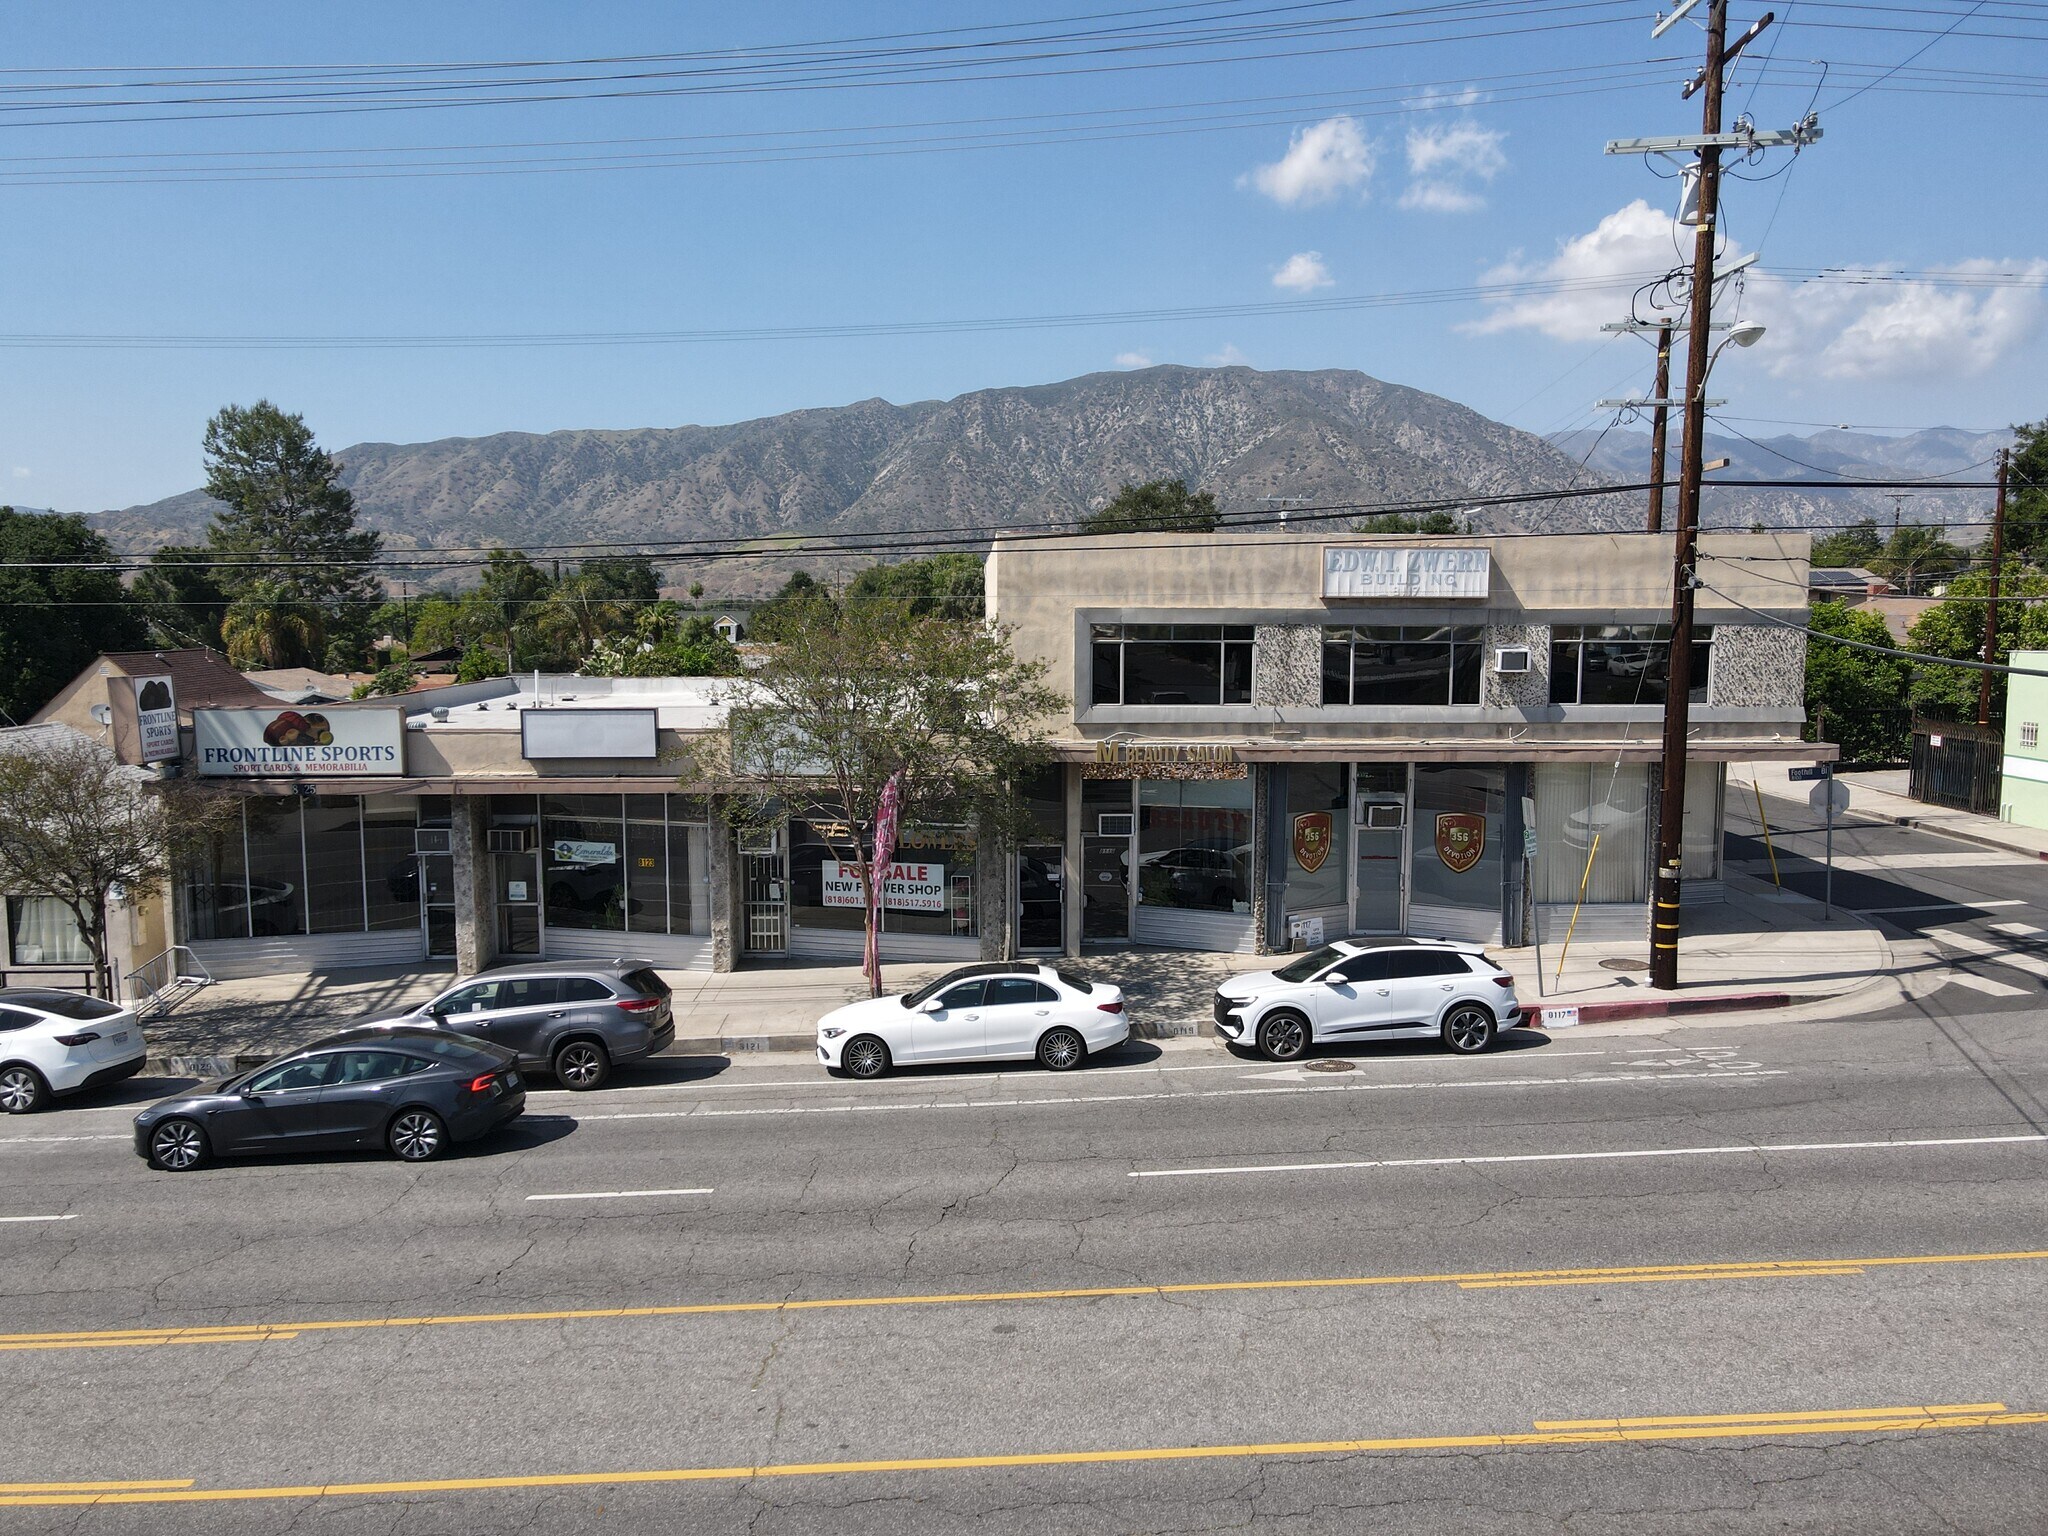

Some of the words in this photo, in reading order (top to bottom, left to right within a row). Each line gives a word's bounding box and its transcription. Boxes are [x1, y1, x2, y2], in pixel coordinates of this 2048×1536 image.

[1407, 550, 1489, 573] ZWERN
[1361, 574, 1457, 586] BUILDNG
[138, 711, 176, 727] FRONTLINE
[146, 725, 172, 739] SPORTS
[204, 746, 316, 763] FRONTLINE
[321, 745, 395, 762] SPORTS
[1125, 745, 1180, 763] BEAUTY
[1186, 745, 1234, 763] SALON
[233, 764, 262, 773] SPORT
[263, 763, 293, 772] CARDS
[293, 764, 301, 772] &
[305, 763, 368, 772] MEMORABILIA
[1305, 832, 1320, 842] 356
[1451, 832, 1469, 842] 356
[1299, 846, 1325, 859] DEVOTION
[1443, 846, 1476, 859] DEVOTION
[825, 881, 853, 892] NEW
[856, 882, 906, 894] FWER
[908, 885, 941, 895] SHOP
[885, 897, 942, 908] (818)517.5916
